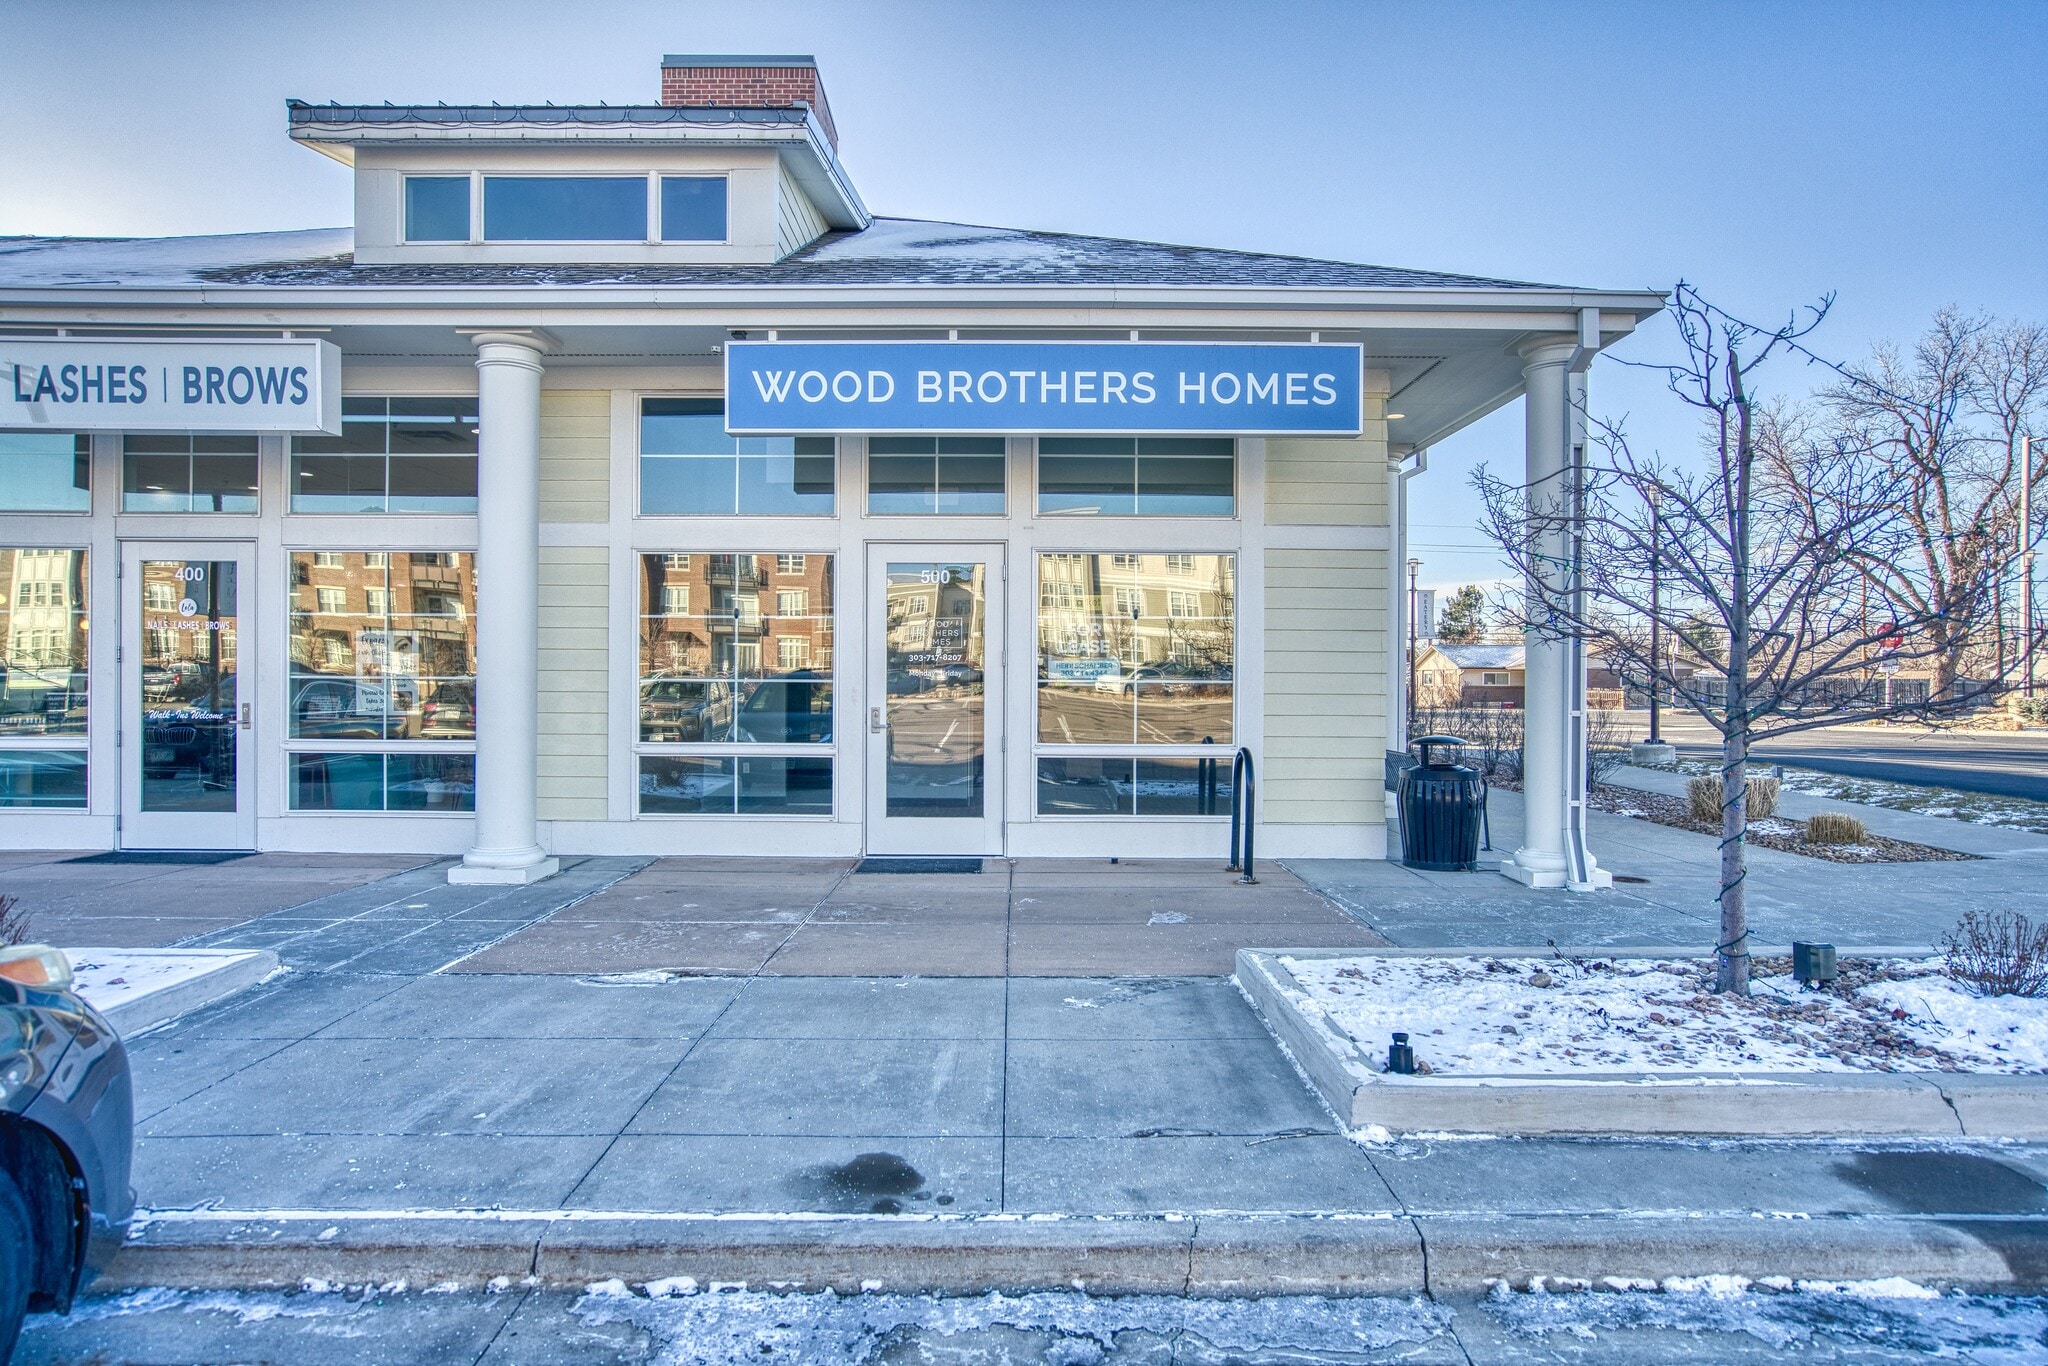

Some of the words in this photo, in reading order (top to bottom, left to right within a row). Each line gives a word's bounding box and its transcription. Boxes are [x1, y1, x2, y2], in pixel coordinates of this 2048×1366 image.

[13, 364, 148, 405] LASHES
[183, 365, 309, 406] BROWS
[751, 370, 896, 404] WOOD
[917, 370, 1157, 405] BROTHERS
[1179, 371, 1338, 406] HOMES
[174, 567, 204, 582] 400
[920, 570, 950, 584] 500
[173, 620, 200, 630] LASHES
[205, 621, 230, 631] BROWS
[908, 653, 962, 662] 303-717-8207
[148, 709, 189, 720] Walk-Ins
[190, 709, 224, 720] Welcome
